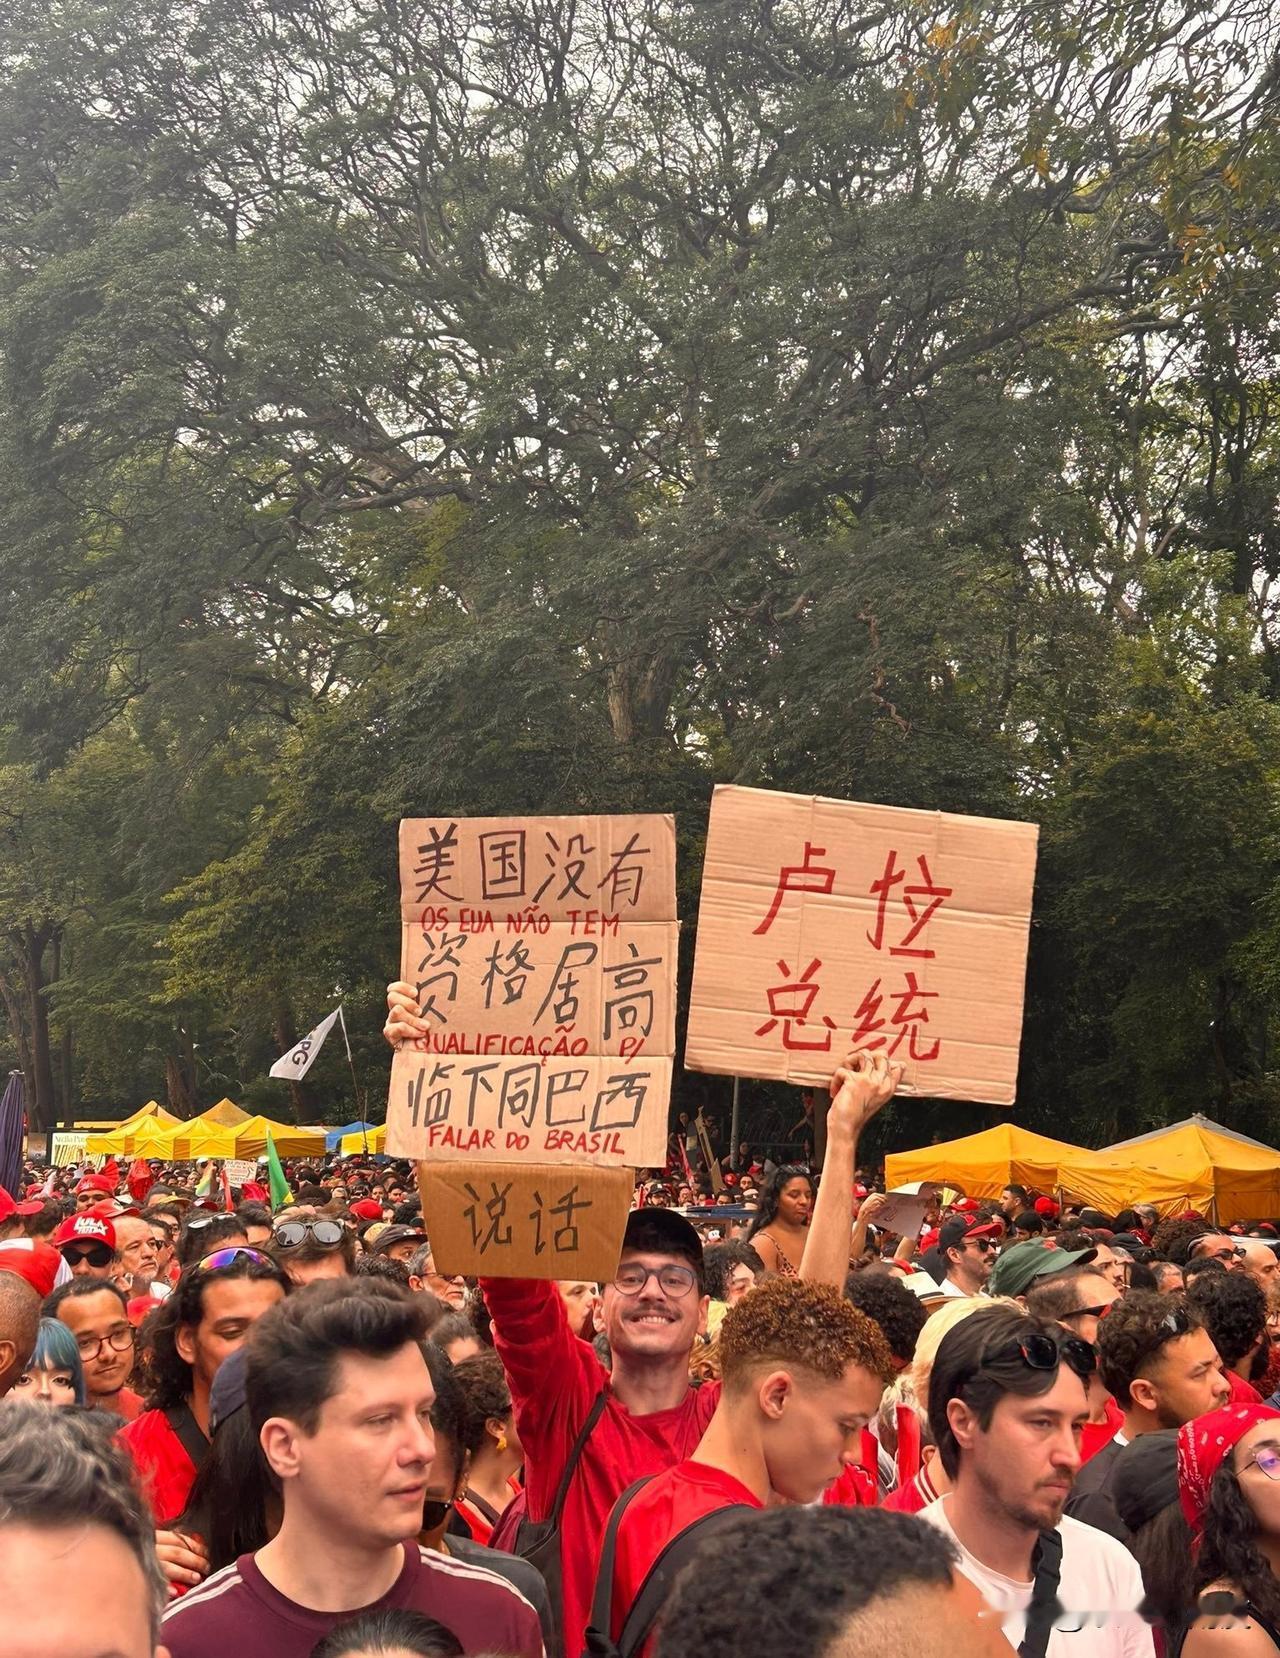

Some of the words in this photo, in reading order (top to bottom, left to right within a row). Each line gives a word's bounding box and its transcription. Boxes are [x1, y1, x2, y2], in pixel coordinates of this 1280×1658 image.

[413, 823, 651, 912] 美国没有
[752, 841, 953, 959] 卢拉
[420, 906, 449, 933] OS
[459, 907, 495, 933] EUA
[506, 905, 551, 935] NÃO
[566, 909, 621, 938] TEM
[415, 932, 663, 1041] 资格居高
[755, 958, 940, 1061] 总统
[619, 1036, 646, 1064] P/
[407, 1062, 651, 1132] 临下同巴西
[428, 1123, 496, 1150] FALAR
[505, 1131, 530, 1150] DO
[543, 1129, 626, 1155] BRASIL
[463, 1182, 593, 1256] 说话
